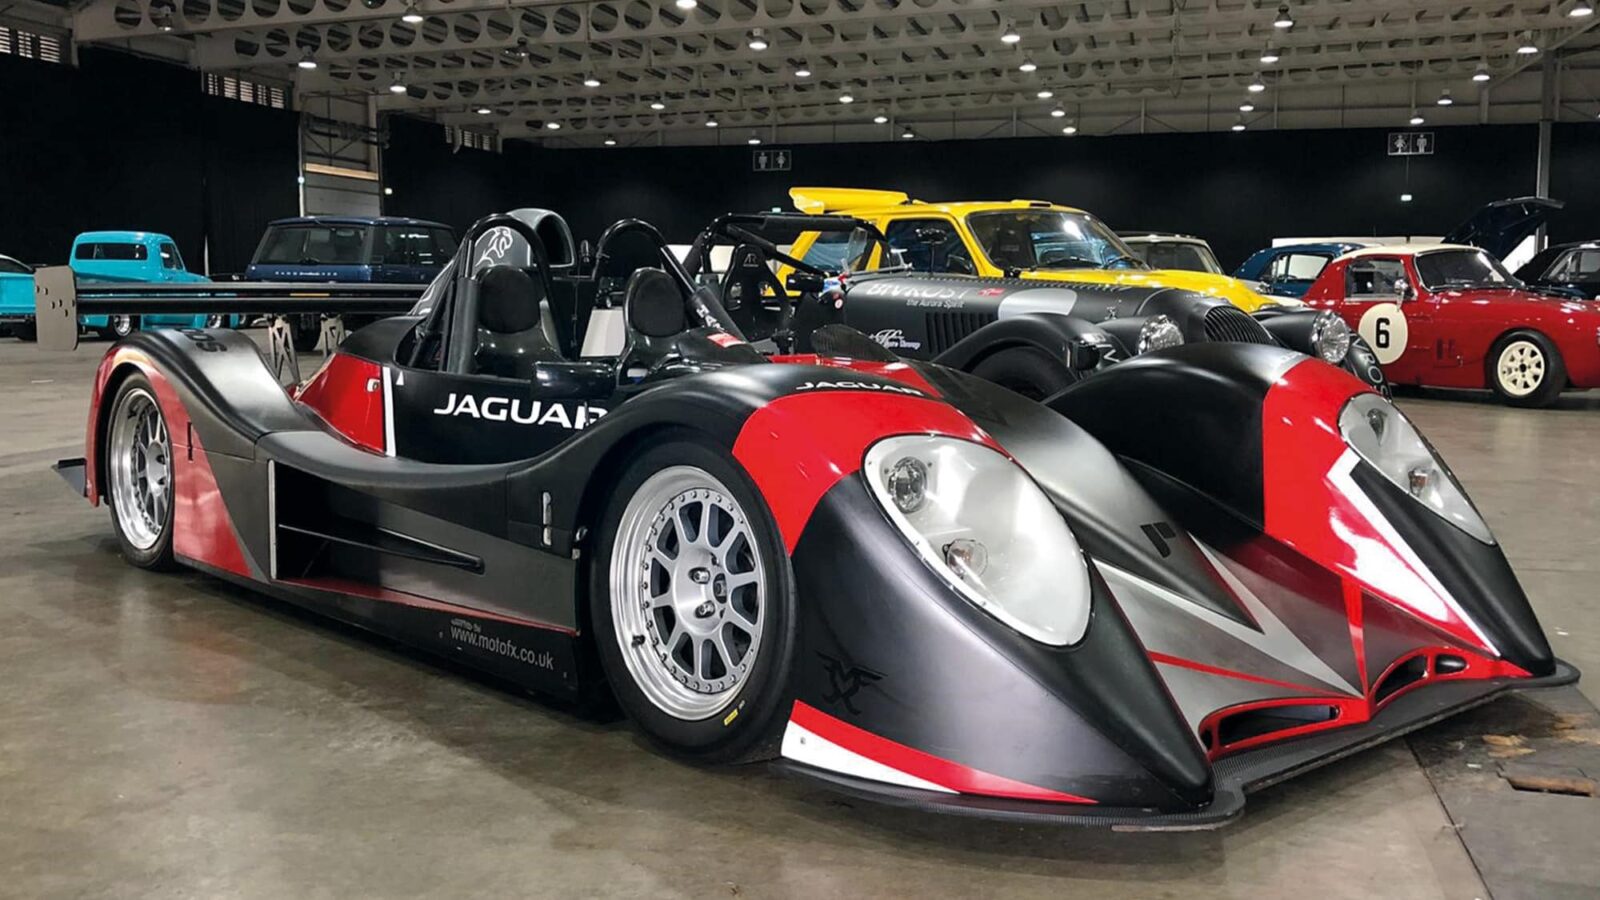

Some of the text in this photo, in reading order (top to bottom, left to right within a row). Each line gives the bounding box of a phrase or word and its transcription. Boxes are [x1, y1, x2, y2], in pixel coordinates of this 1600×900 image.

[906, 299, 918, 307] the
[1375, 317, 1390, 349] 6
[796, 381, 925, 397] JAGUAR
[433, 392, 609, 430] JAGUAR
[450, 626, 554, 671] www.motofx.co.uk
